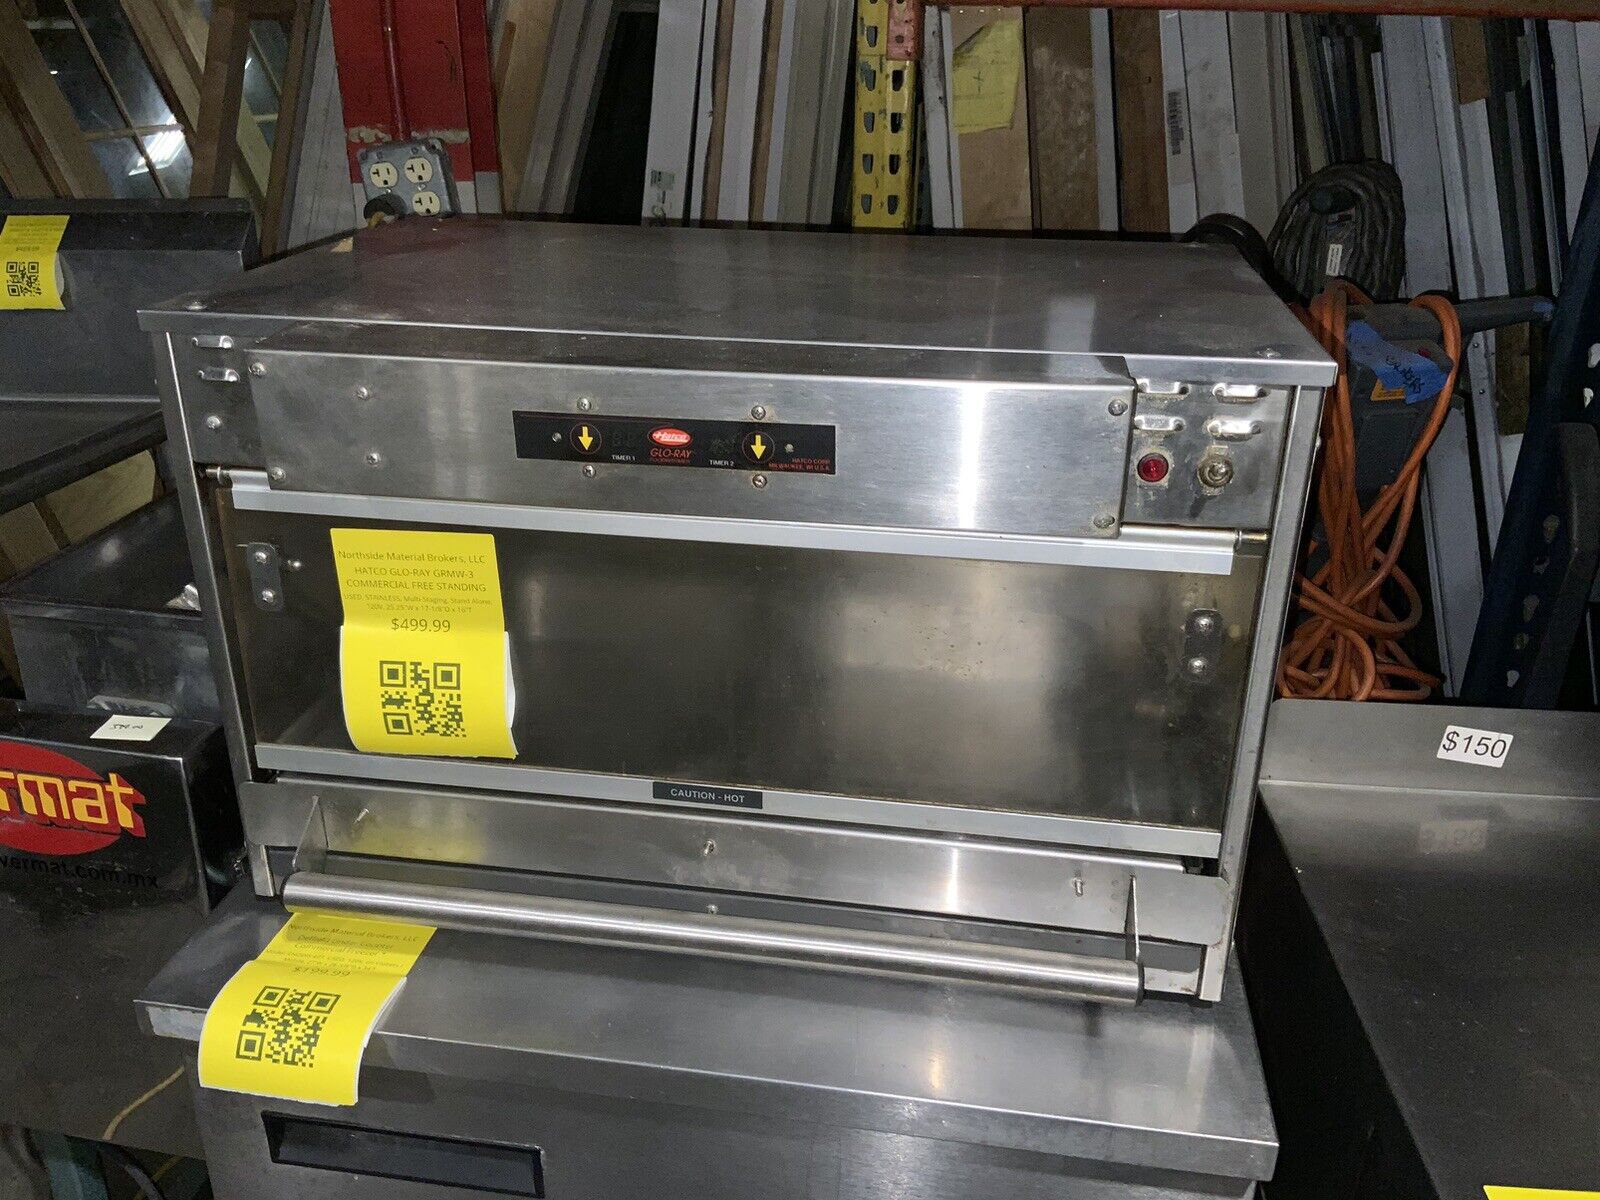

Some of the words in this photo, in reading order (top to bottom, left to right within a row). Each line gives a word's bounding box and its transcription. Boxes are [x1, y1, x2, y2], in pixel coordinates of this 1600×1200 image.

[650, 448, 691, 459] GLO-RAY
[709, 459, 730, 467] TIMER
[338, 550, 384, 560] Northside
[386, 552, 424, 561] Material
[427, 554, 466, 563] Brokers,
[468, 555, 486, 564] LLC
[354, 567, 388, 576] HATCO
[389, 568, 431, 577] GLO-RAY
[433, 569, 474, 578] GRMW-3
[346, 580, 410, 589] COMMERCIAL
[411, 581, 434, 590] FREE
[436, 583, 487, 592] STANDING
[391, 618, 451, 632] $499.99
[1442, 730, 1507, 759] $150
[670, 788, 716, 801] CAUTION
[723, 794, 746, 804] HOT
